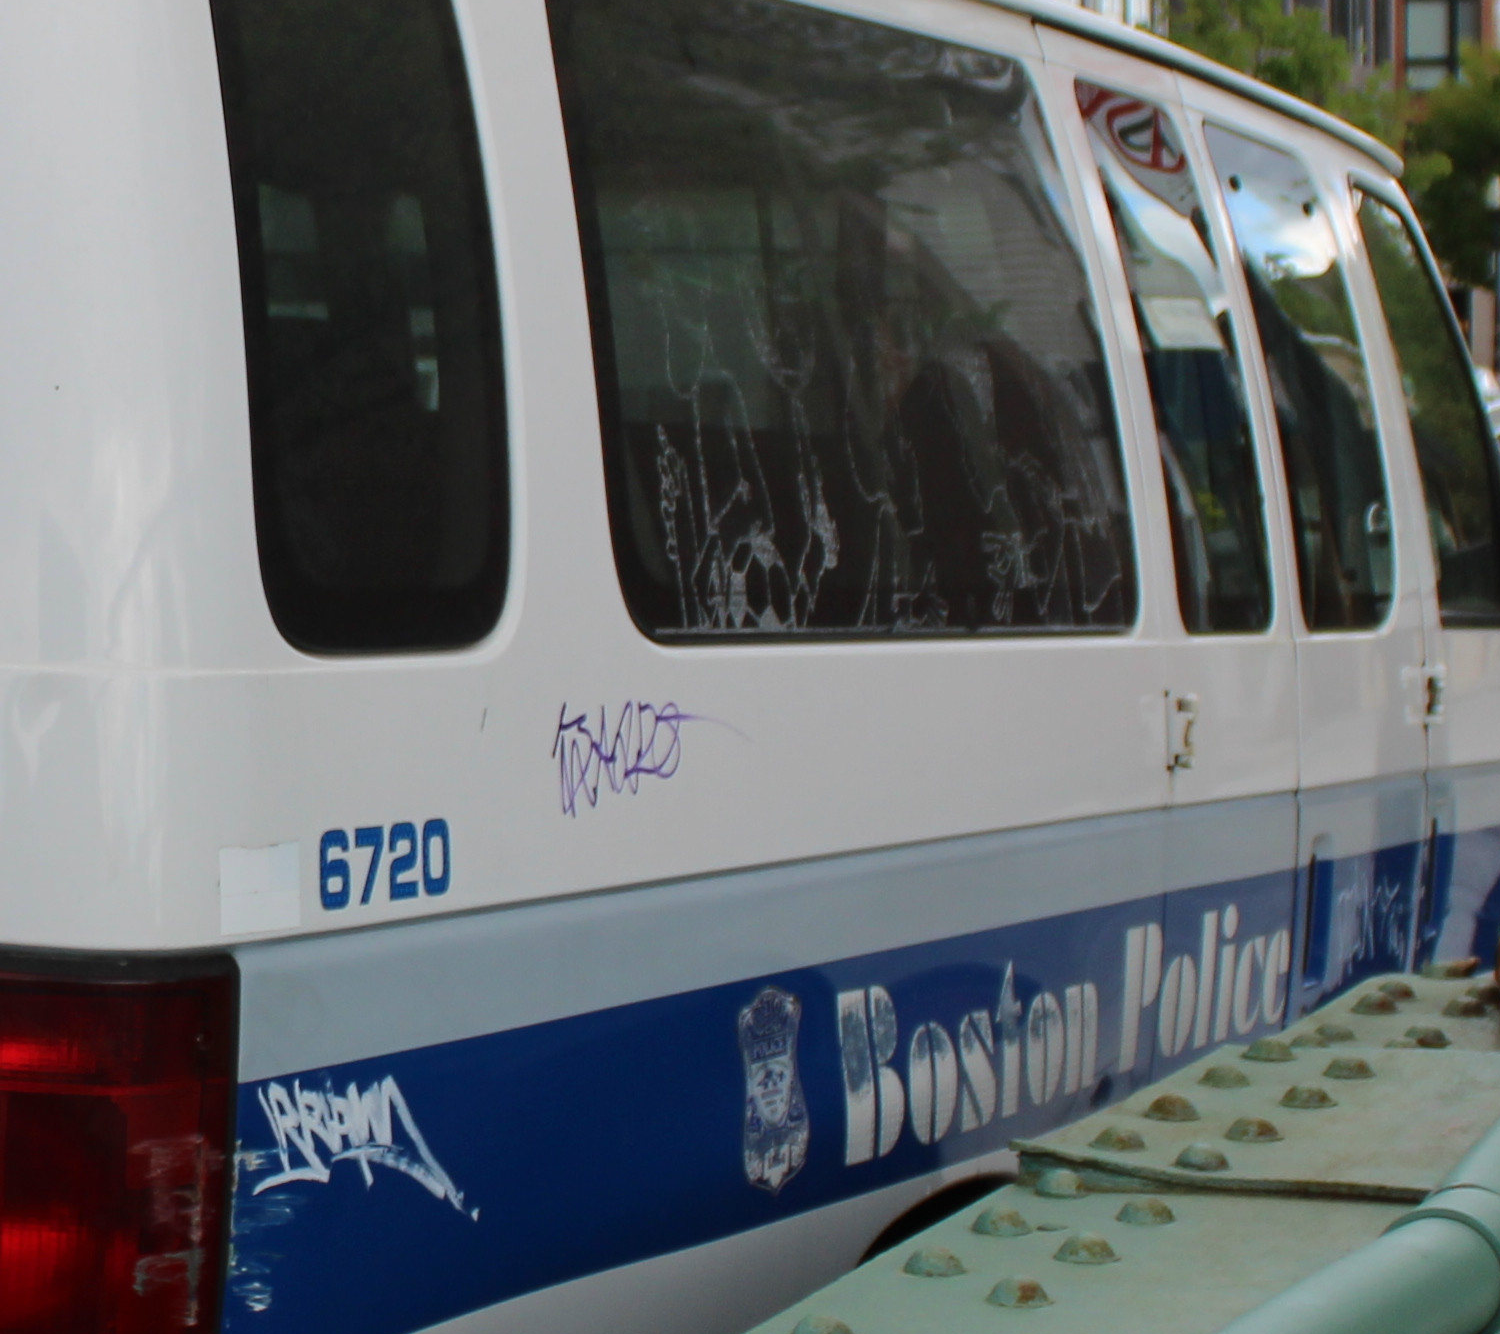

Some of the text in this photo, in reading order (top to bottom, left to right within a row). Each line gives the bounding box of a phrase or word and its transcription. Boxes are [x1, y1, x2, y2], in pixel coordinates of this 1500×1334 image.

[319, 818, 451, 911] 6720
[836, 959, 1099, 1167] Boston
[1118, 903, 1291, 1074] Police
